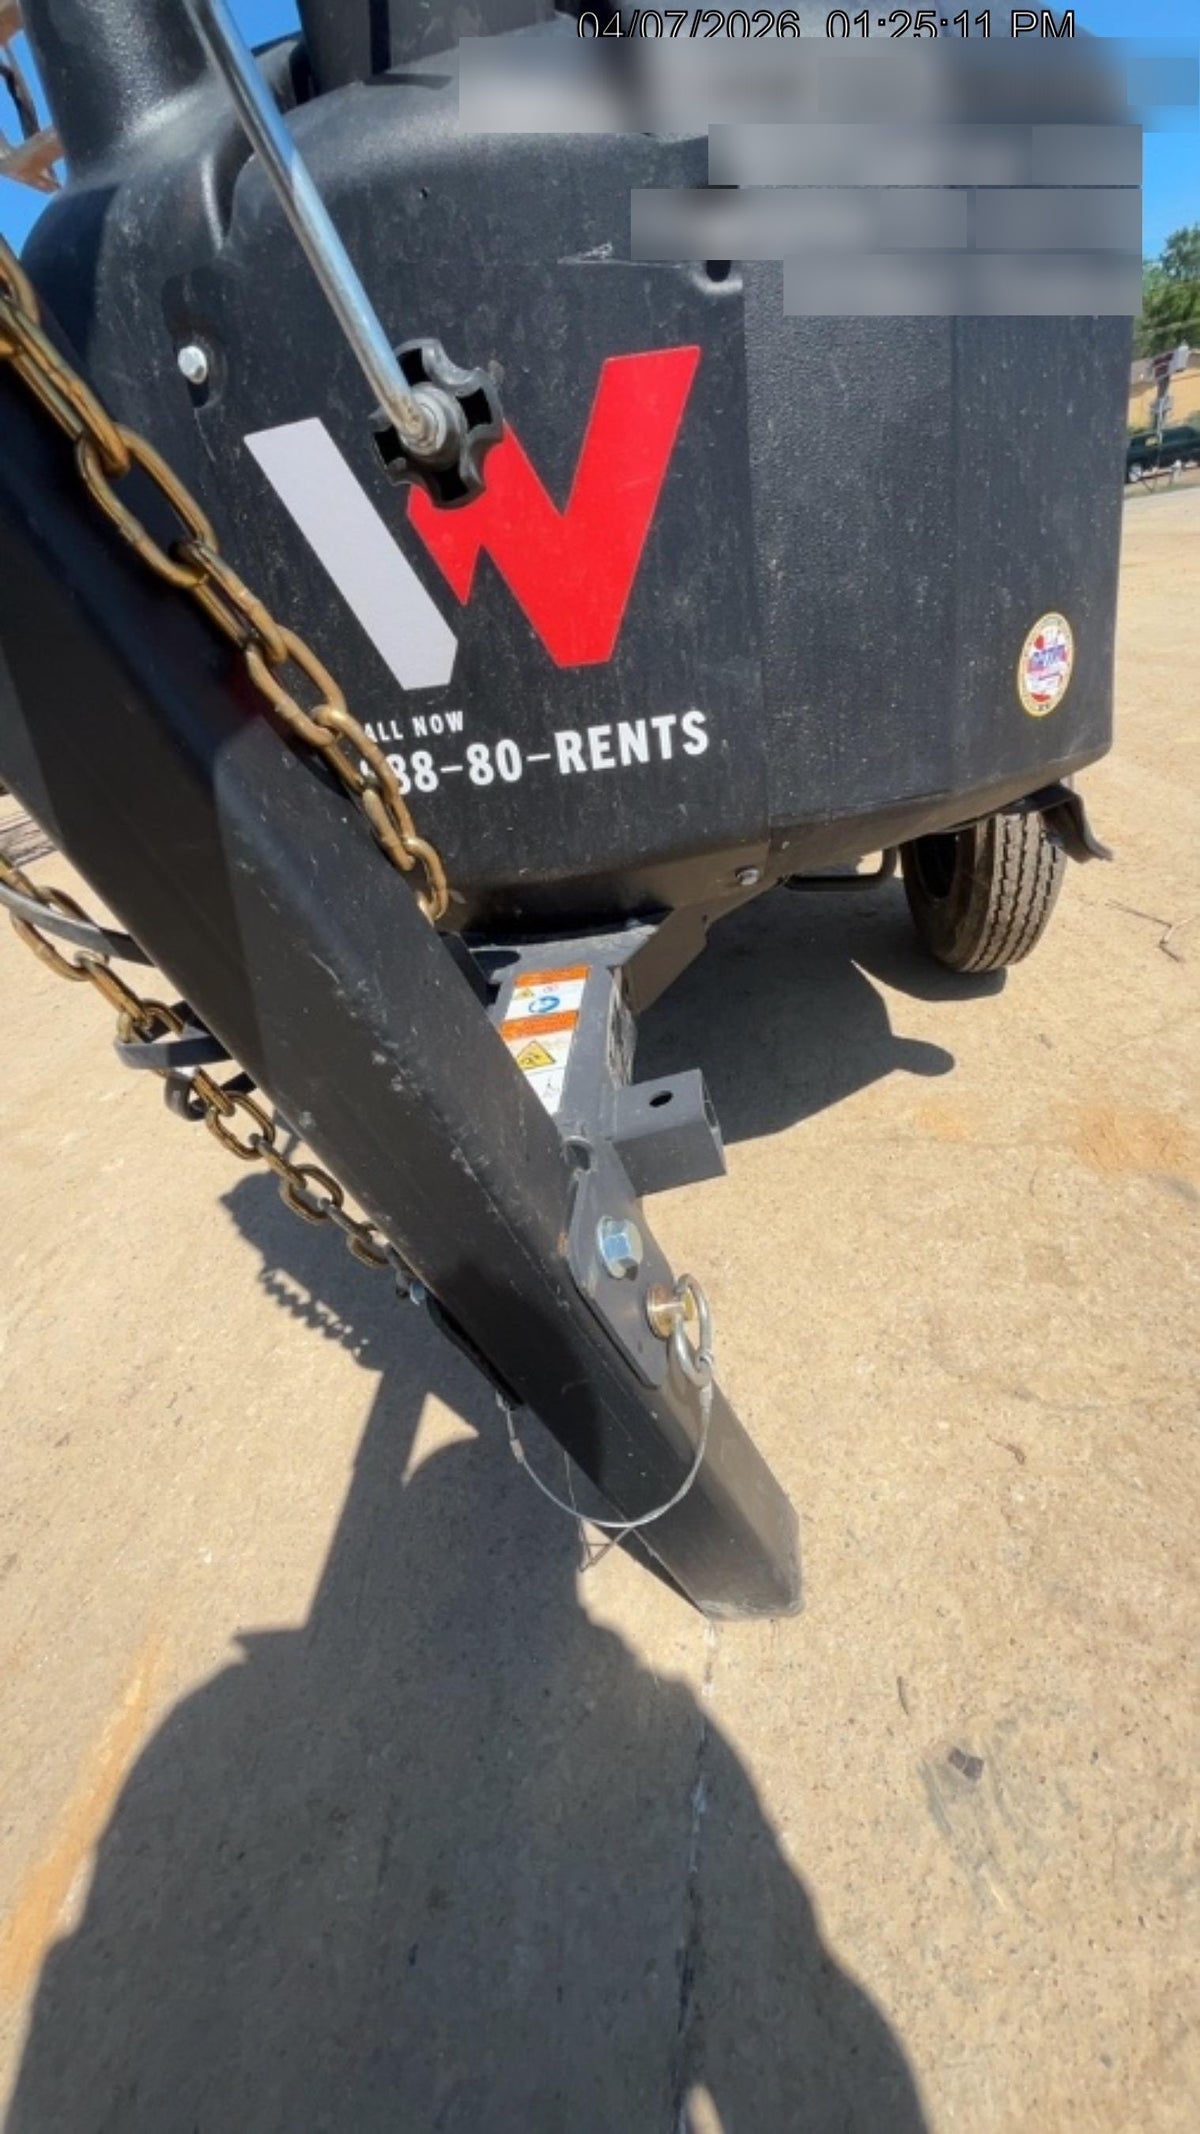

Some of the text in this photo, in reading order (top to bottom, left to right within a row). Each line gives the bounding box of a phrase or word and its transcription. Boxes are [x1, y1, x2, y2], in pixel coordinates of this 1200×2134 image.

[360, 711, 710, 795] 88-80-RENTS
[364, 711, 463, 743] ALL NOW
